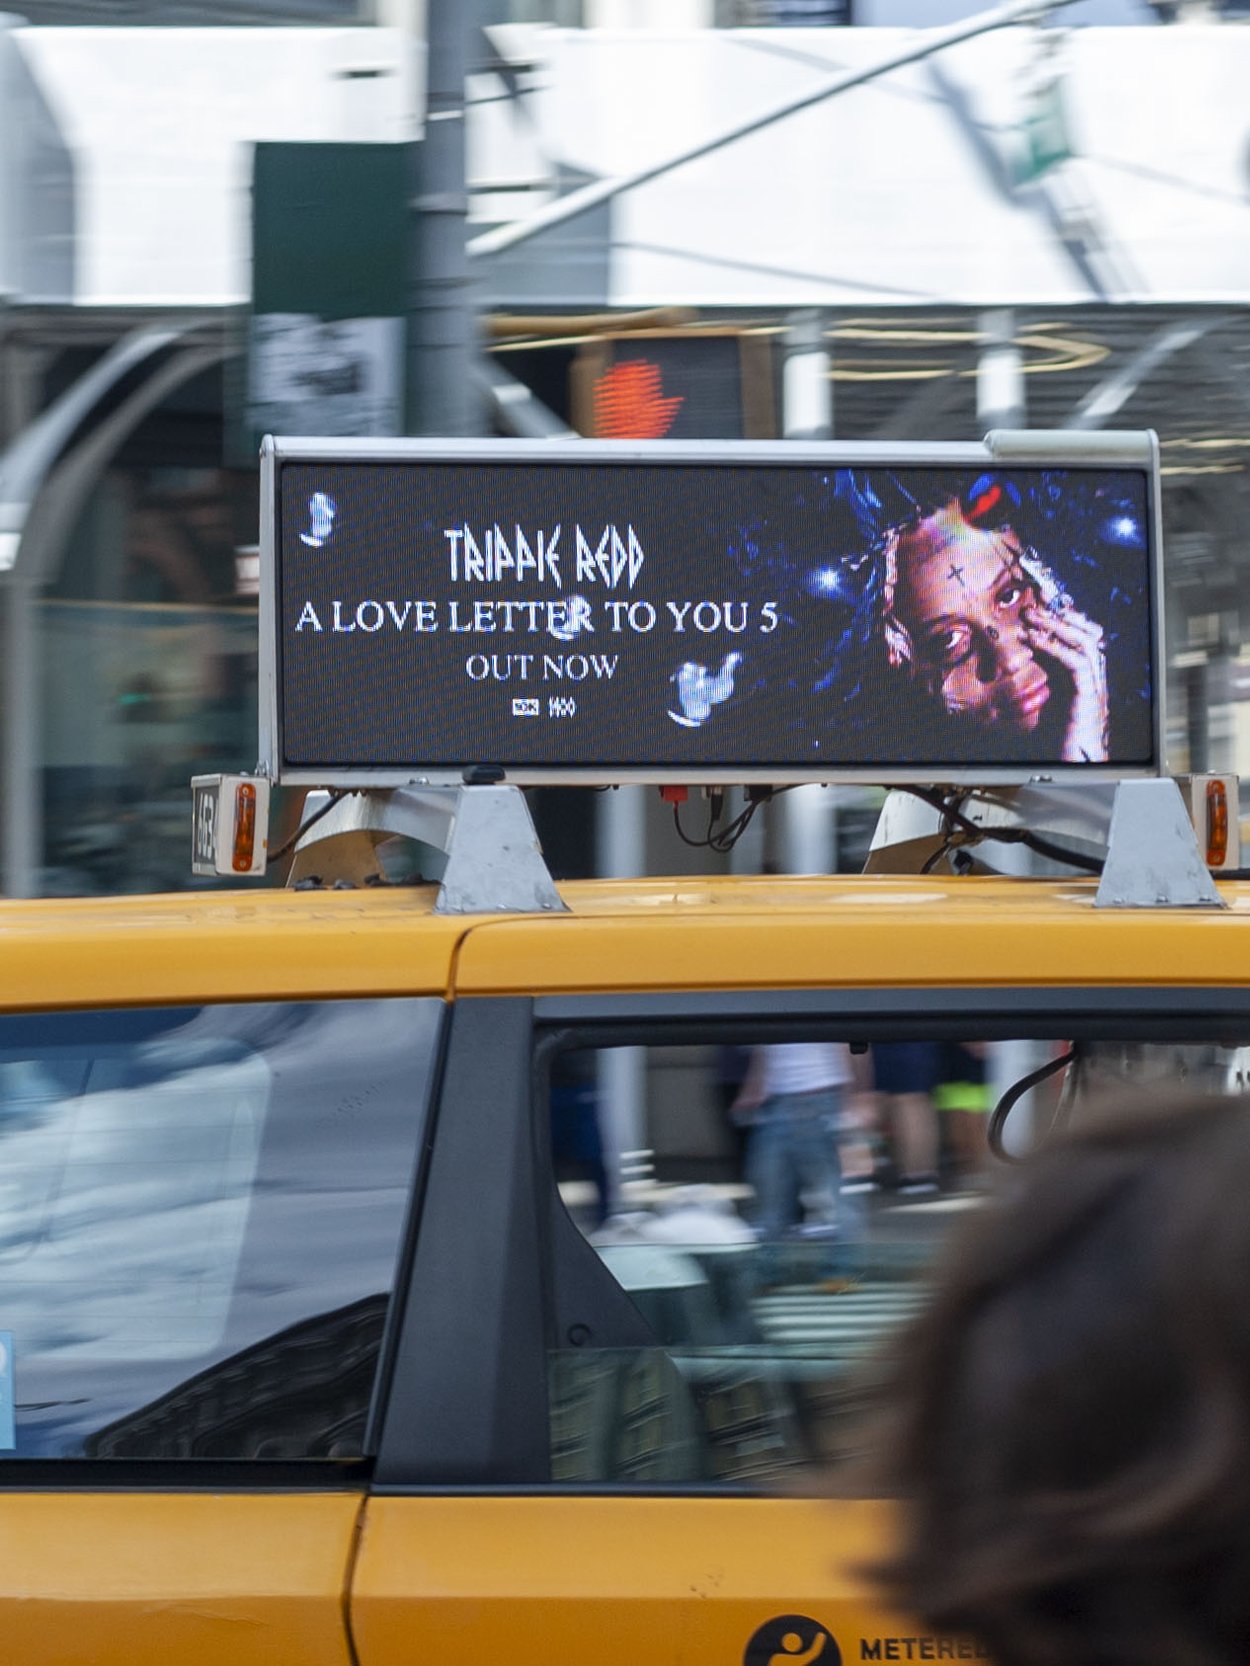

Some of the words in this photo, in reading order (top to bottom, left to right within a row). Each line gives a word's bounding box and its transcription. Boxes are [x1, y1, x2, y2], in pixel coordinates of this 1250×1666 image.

[444, 523, 562, 589] TRIPPIE
[576, 523, 644, 589] REDD
[295, 601, 323, 632] A
[332, 601, 439, 632] LOVE
[449, 600, 595, 633] LETTER
[604, 601, 656, 632] TO
[666, 601, 748, 632] YOU
[759, 601, 779, 632] 5
[465, 654, 534, 680] OUT
[543, 654, 619, 680] NOW
